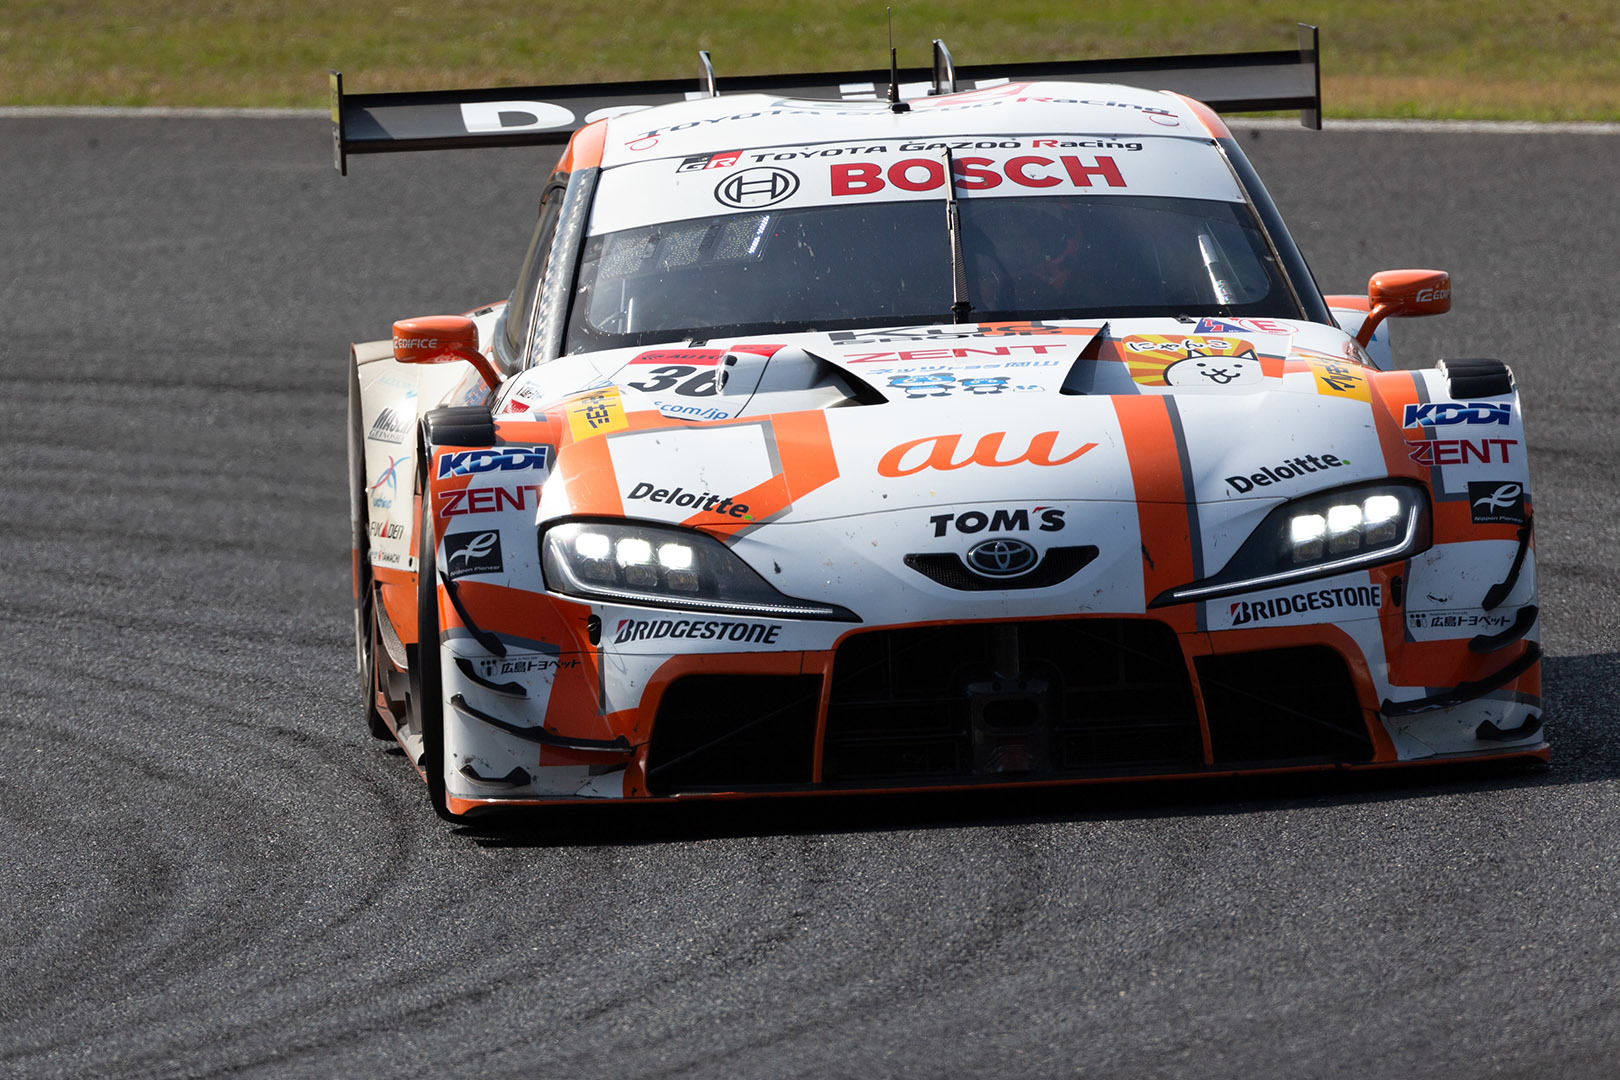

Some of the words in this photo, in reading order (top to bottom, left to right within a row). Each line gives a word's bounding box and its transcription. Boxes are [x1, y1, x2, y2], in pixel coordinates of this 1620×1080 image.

[750, 145, 888, 163] TOYOTA
[899, 140, 1021, 151] GAZOO
[1032, 139, 1143, 151] Racing
[830, 155, 1127, 195] BOSCH
[398, 338, 438, 349] EDIFICE
[844, 344, 1067, 364] ZENT
[627, 366, 728, 397] 36
[1404, 403, 1512, 428] KDDI
[438, 447, 547, 479] KDDI
[877, 430, 1099, 478] au
[1404, 439, 1518, 465] ZENT
[439, 485, 541, 518] ZENT
[930, 506, 1066, 537] TOM'S
[1230, 585, 1382, 626] BRIDGESTONE
[614, 619, 782, 645] BRIDGESTONE
[1431, 615, 1511, 628] 広島トヨペット
[501, 659, 582, 675] 広島トヨペット
